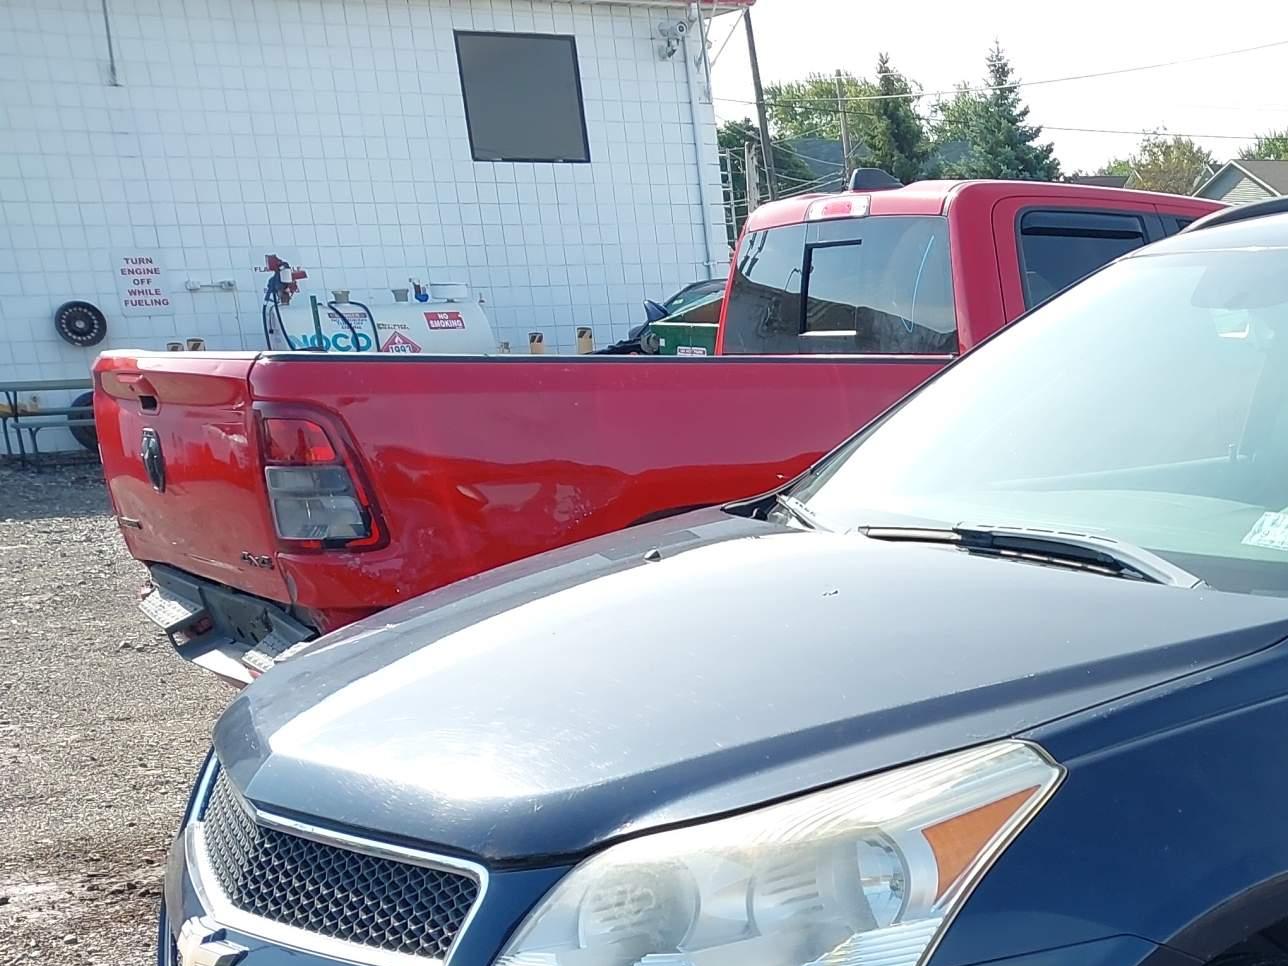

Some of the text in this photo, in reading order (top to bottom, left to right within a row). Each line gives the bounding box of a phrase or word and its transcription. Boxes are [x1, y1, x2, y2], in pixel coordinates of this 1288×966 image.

[120, 267, 160, 275] ENGINE
[132, 278, 152, 286] OFF
[127, 288, 161, 296] WHILE
[123, 298, 169, 307] FUELING
[429, 320, 462, 328] SMOKING
